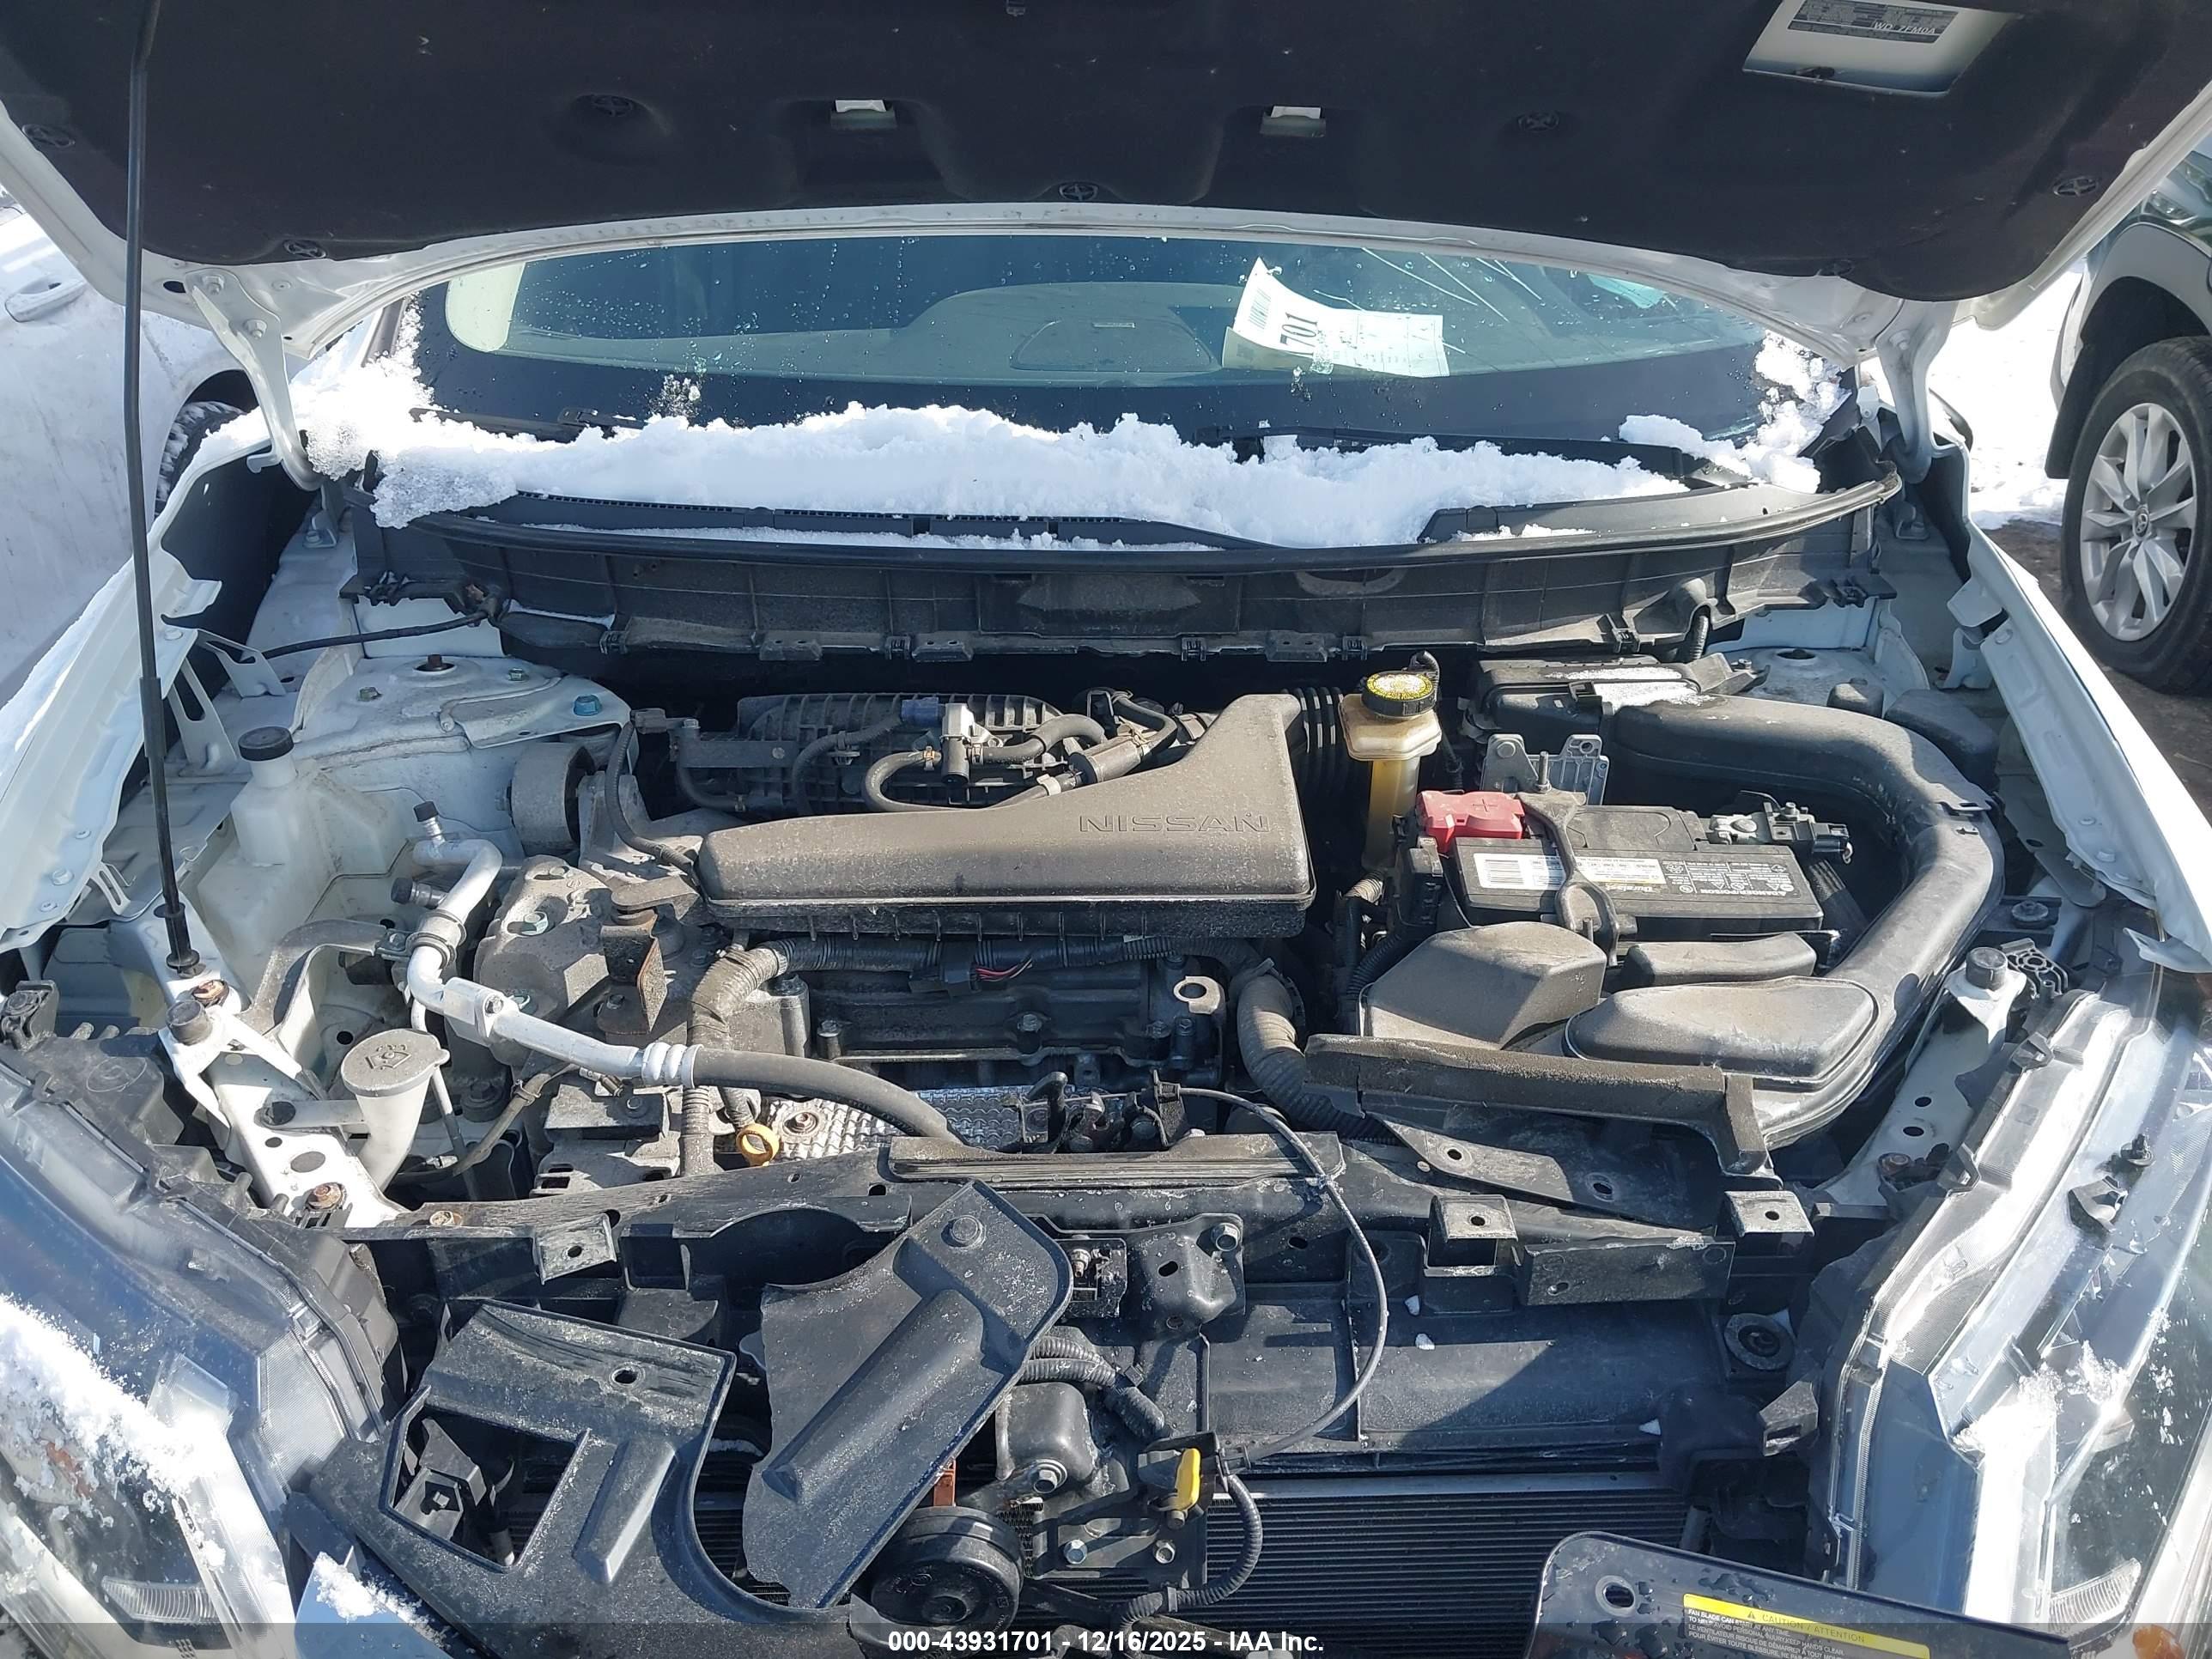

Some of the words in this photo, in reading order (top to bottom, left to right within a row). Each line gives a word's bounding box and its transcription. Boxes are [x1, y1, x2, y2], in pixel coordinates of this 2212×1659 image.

[1079, 814, 1270, 833] NISSAN
[1688, 1608, 1700, 1617] FAN
[1700, 1611, 1720, 1621] BLADE
[1713, 1622, 1732, 1632] AVOID
[1733, 1626, 1765, 1639] PERSONAL
[1802, 1642, 1823, 1652] HANDS
[1762, 1613, 1803, 1630] CAUTION
[1814, 1626, 1865, 1642] ATTENTION
[1688, 1631, 1706, 1640] POUR
[1707, 1634, 1727, 1645] ÉVITER
[1728, 1639, 1747, 1650] TOUTE
[1697, 1626, 1735, 1639] VENTILATEUR
[1735, 1634, 1758, 1645] RISQUE
[1807, 1650, 1822, 1659] TOUT
